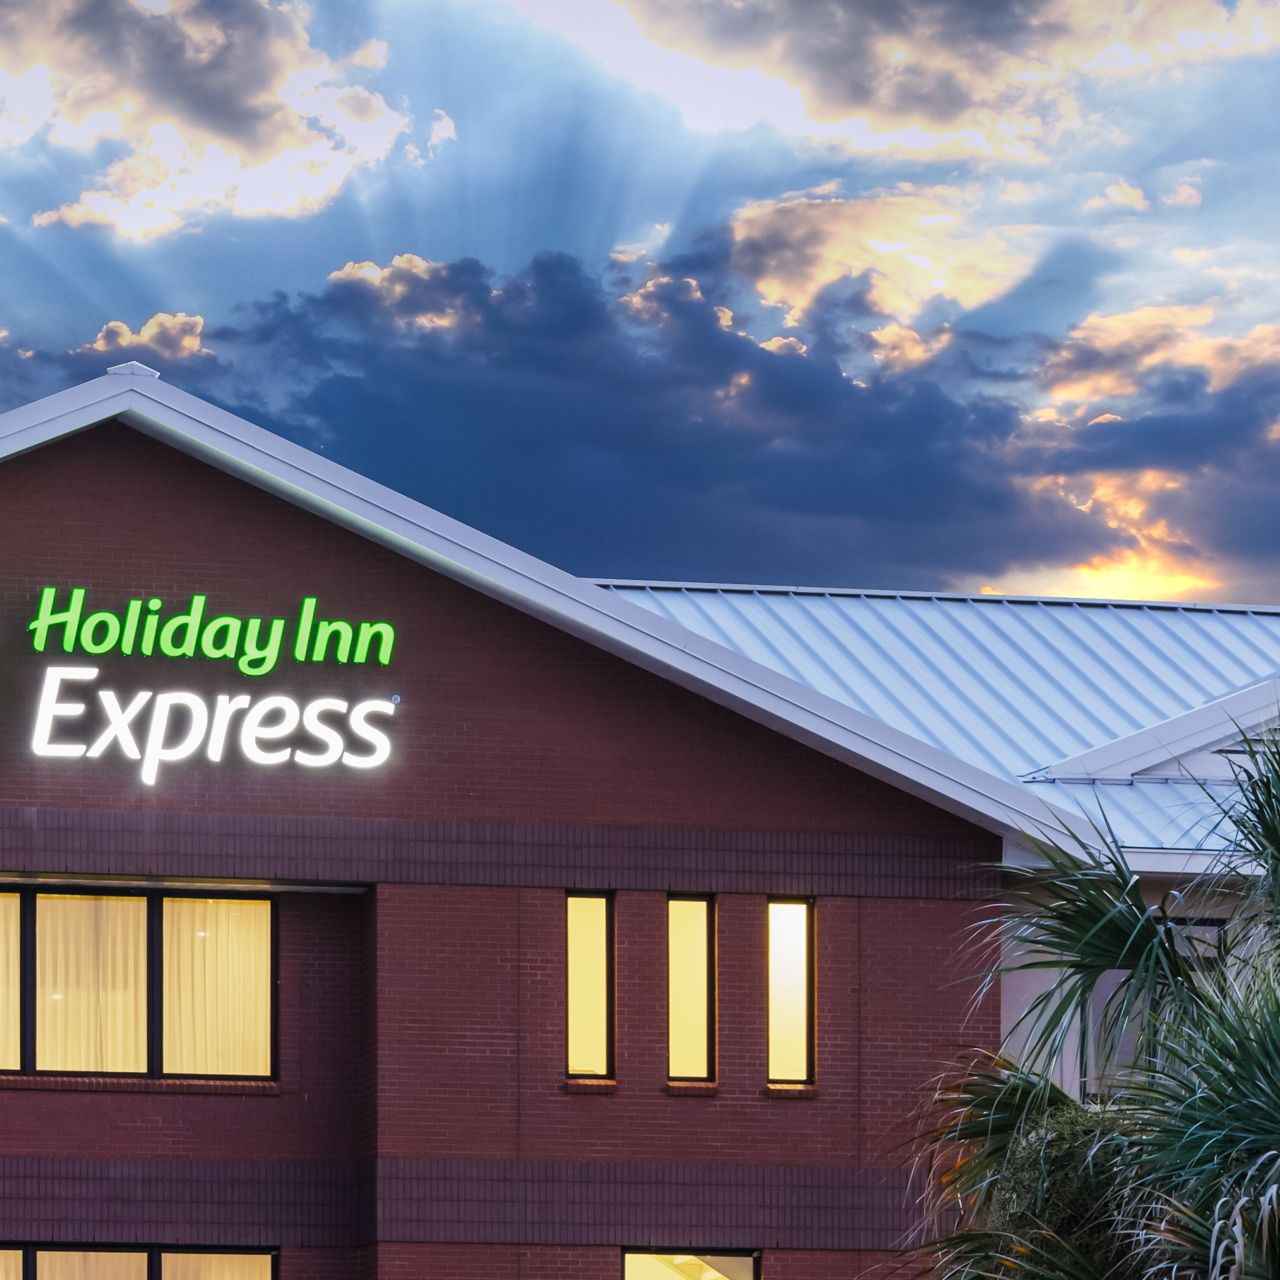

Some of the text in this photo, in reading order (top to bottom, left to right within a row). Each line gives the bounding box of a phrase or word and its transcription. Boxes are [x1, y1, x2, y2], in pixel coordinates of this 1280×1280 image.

[27, 586, 396, 676] Holiday Inn
[31, 666, 396, 786] Express
